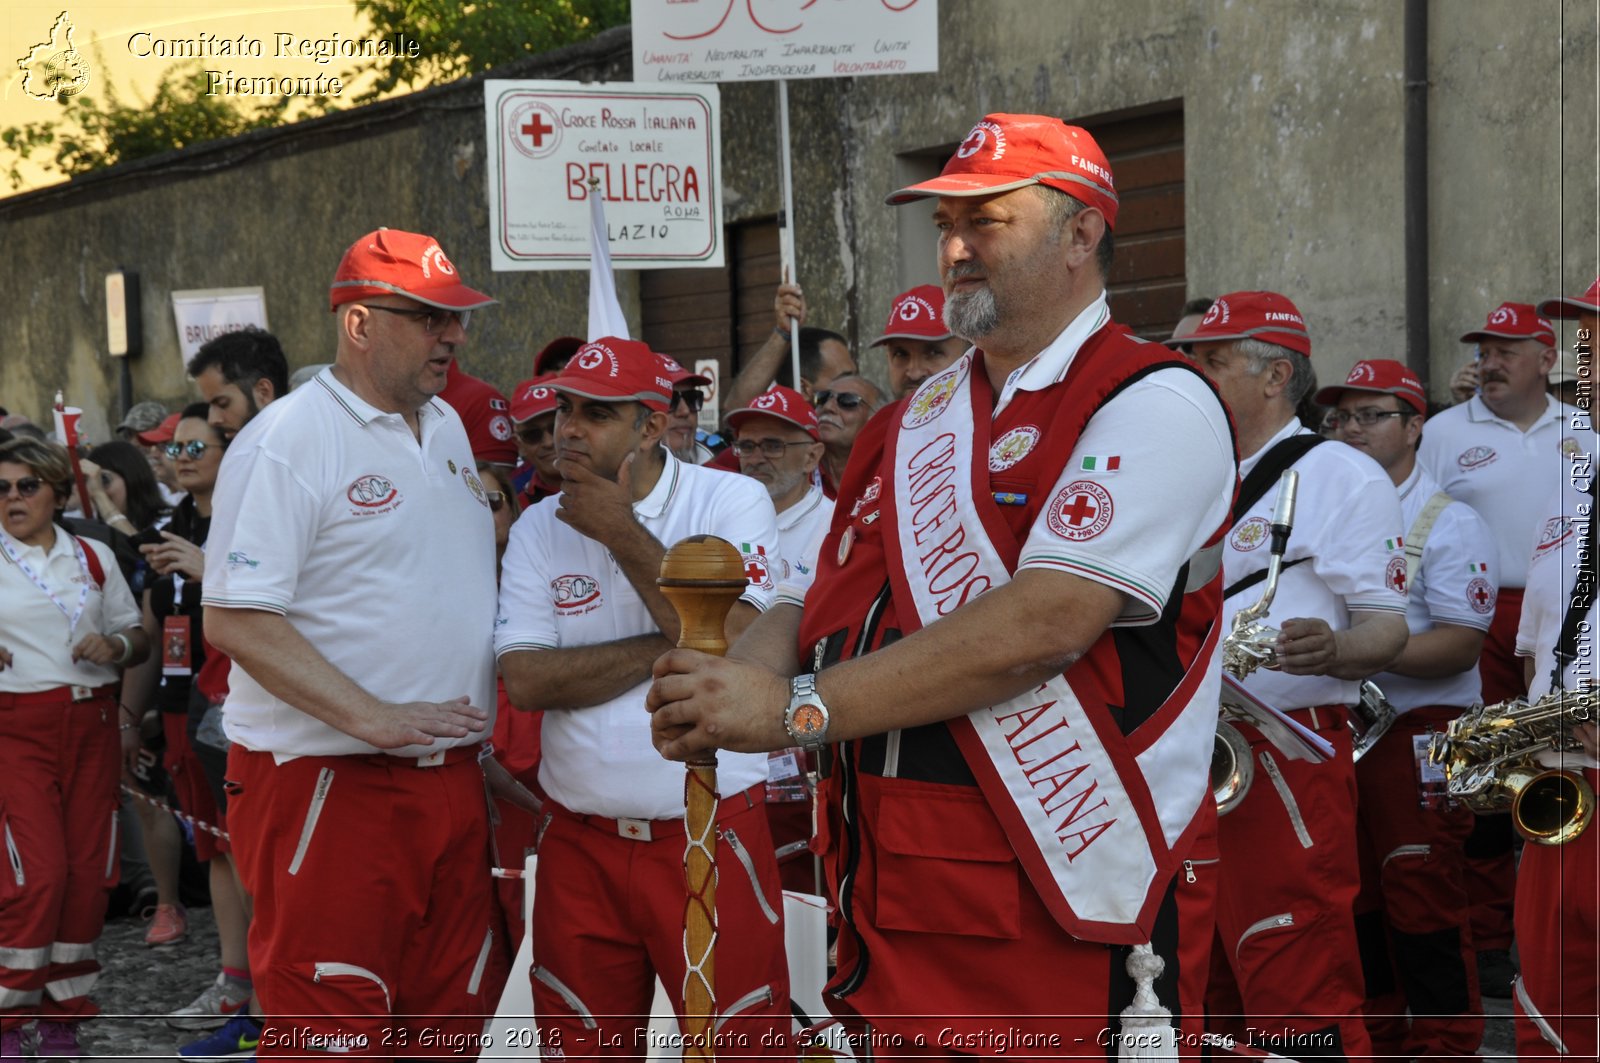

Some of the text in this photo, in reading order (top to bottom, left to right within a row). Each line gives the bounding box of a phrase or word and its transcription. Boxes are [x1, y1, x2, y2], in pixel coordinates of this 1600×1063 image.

[833, 60, 906, 73] VOLONTARIATO
[561, 107, 596, 129] CROCE
[601, 107, 636, 129] ROSSA
[989, 124, 1007, 161] ITALIANA
[566, 162, 699, 202] BELLEGRA
[664, 205, 700, 217] ROMA
[607, 223, 669, 241] LAZIO
[604, 347, 620, 377] ITALIANA
[1094, 502, 1110, 531] AGOSTO
[908, 432, 1118, 864] CROCE ROS ALIANA
